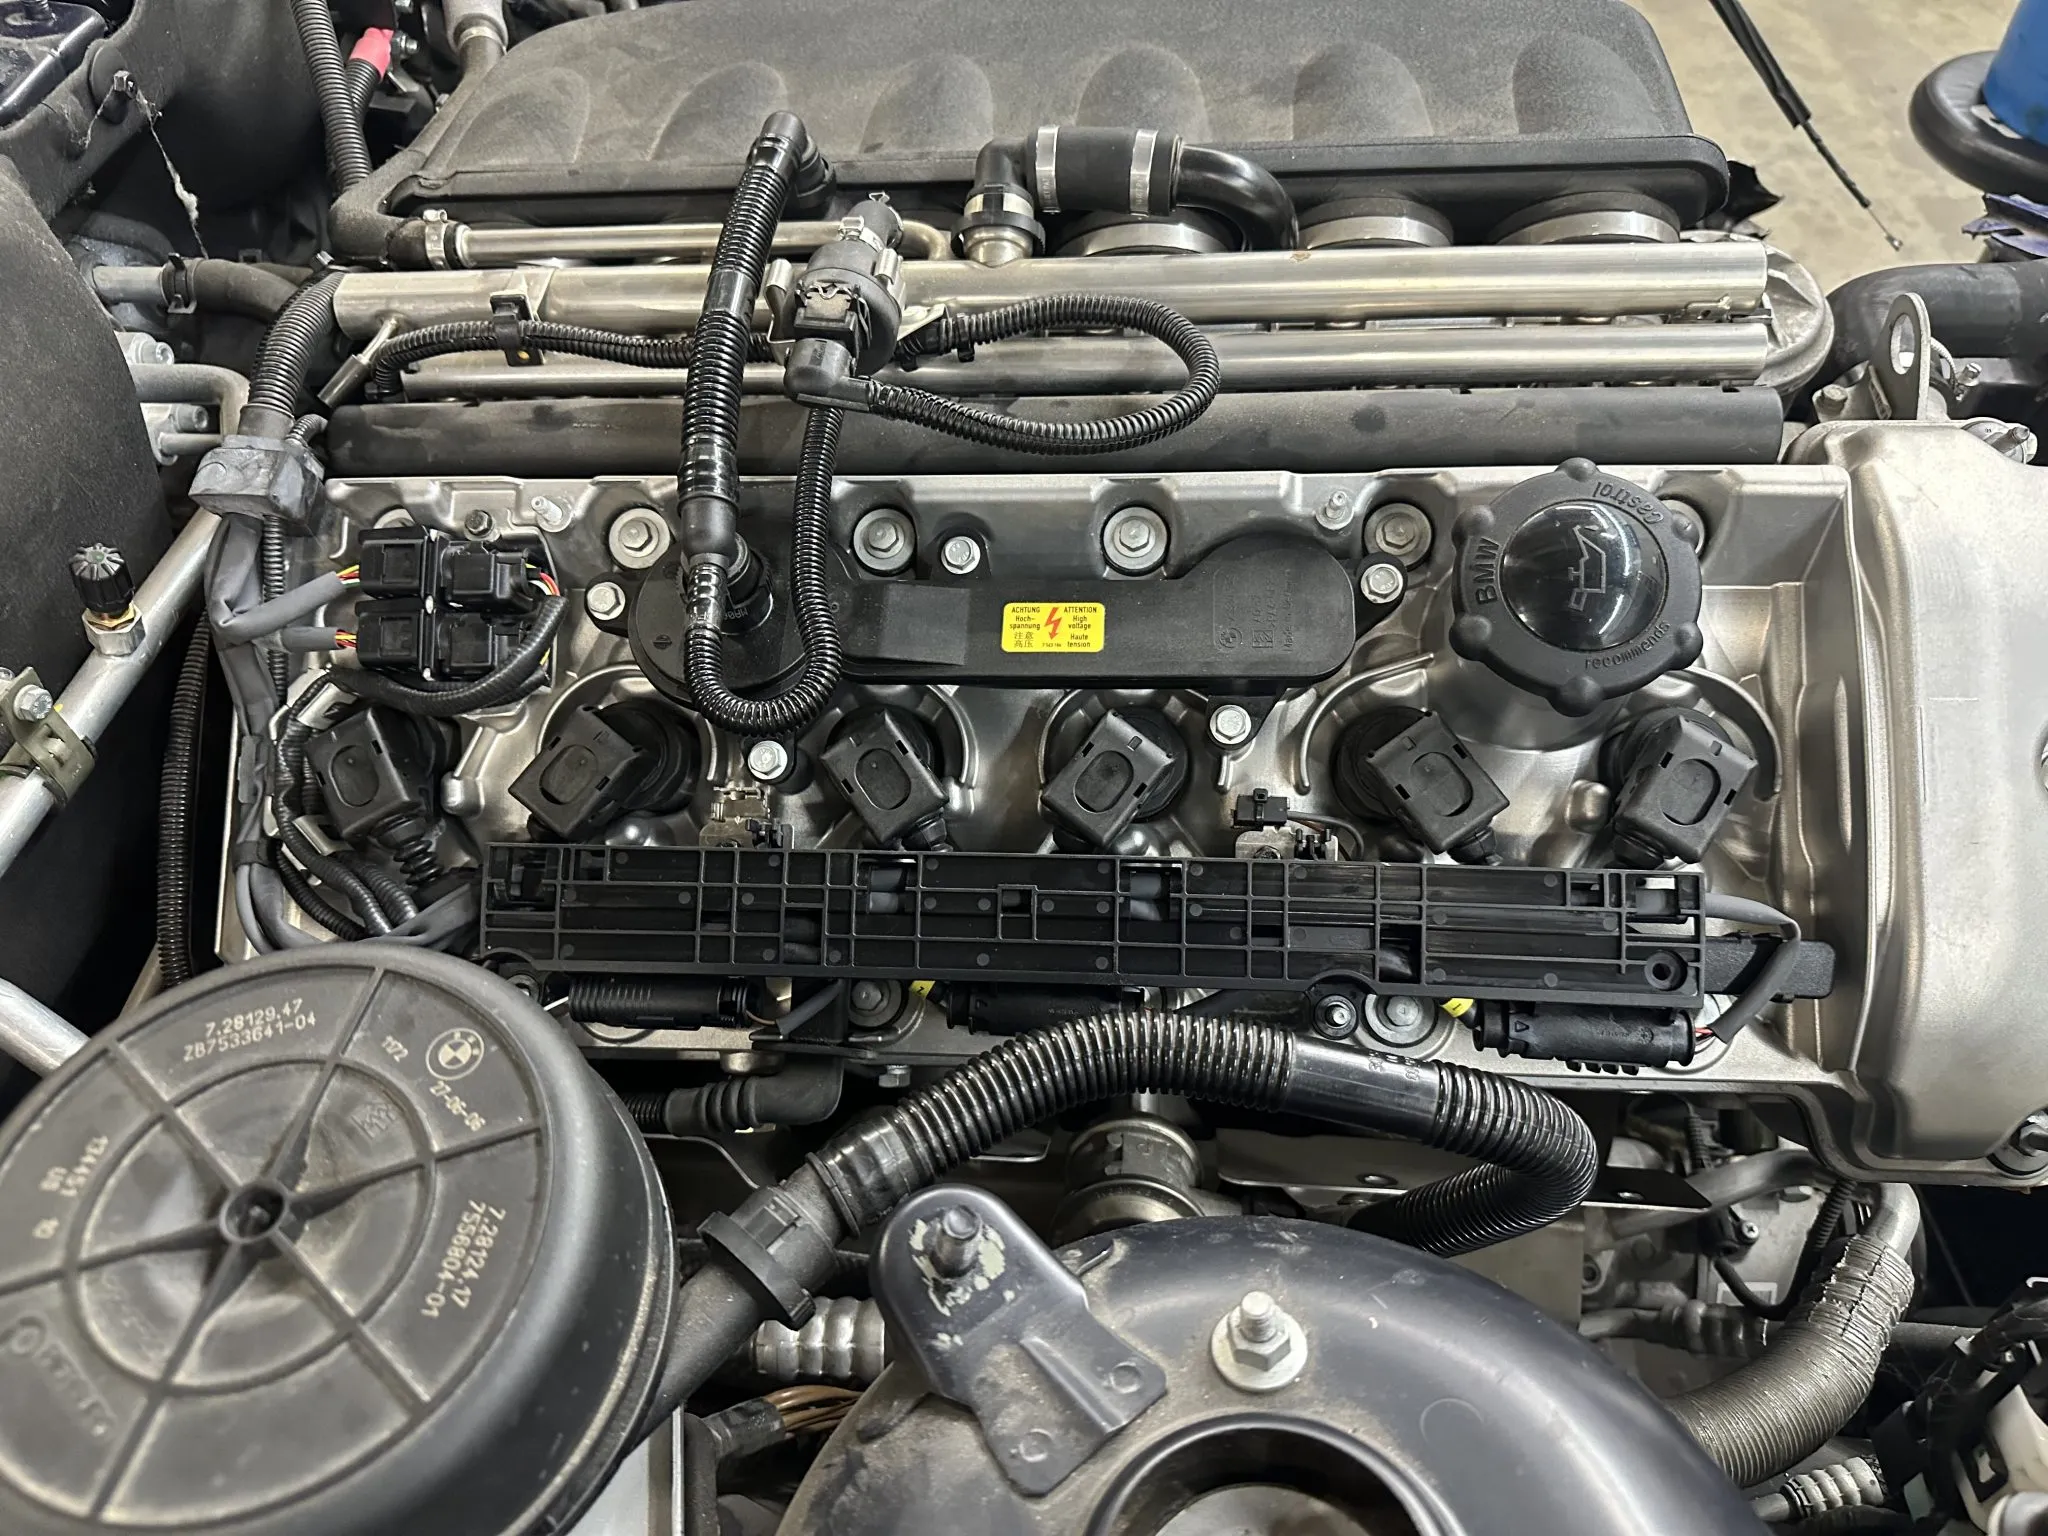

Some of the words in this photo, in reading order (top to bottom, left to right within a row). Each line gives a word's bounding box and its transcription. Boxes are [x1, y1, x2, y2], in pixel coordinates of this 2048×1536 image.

[1593, 481, 1664, 525] Castrol
[1475, 537, 1500, 605] BMW
[1072, 615, 1087, 623] High
[1584, 620, 1671, 669] recommends
[183, 1011, 316, 1062] ZB7533641-04
[205, 998, 303, 1037] 7.28129.47
[450, 1205, 506, 1309] 7.28124.17
